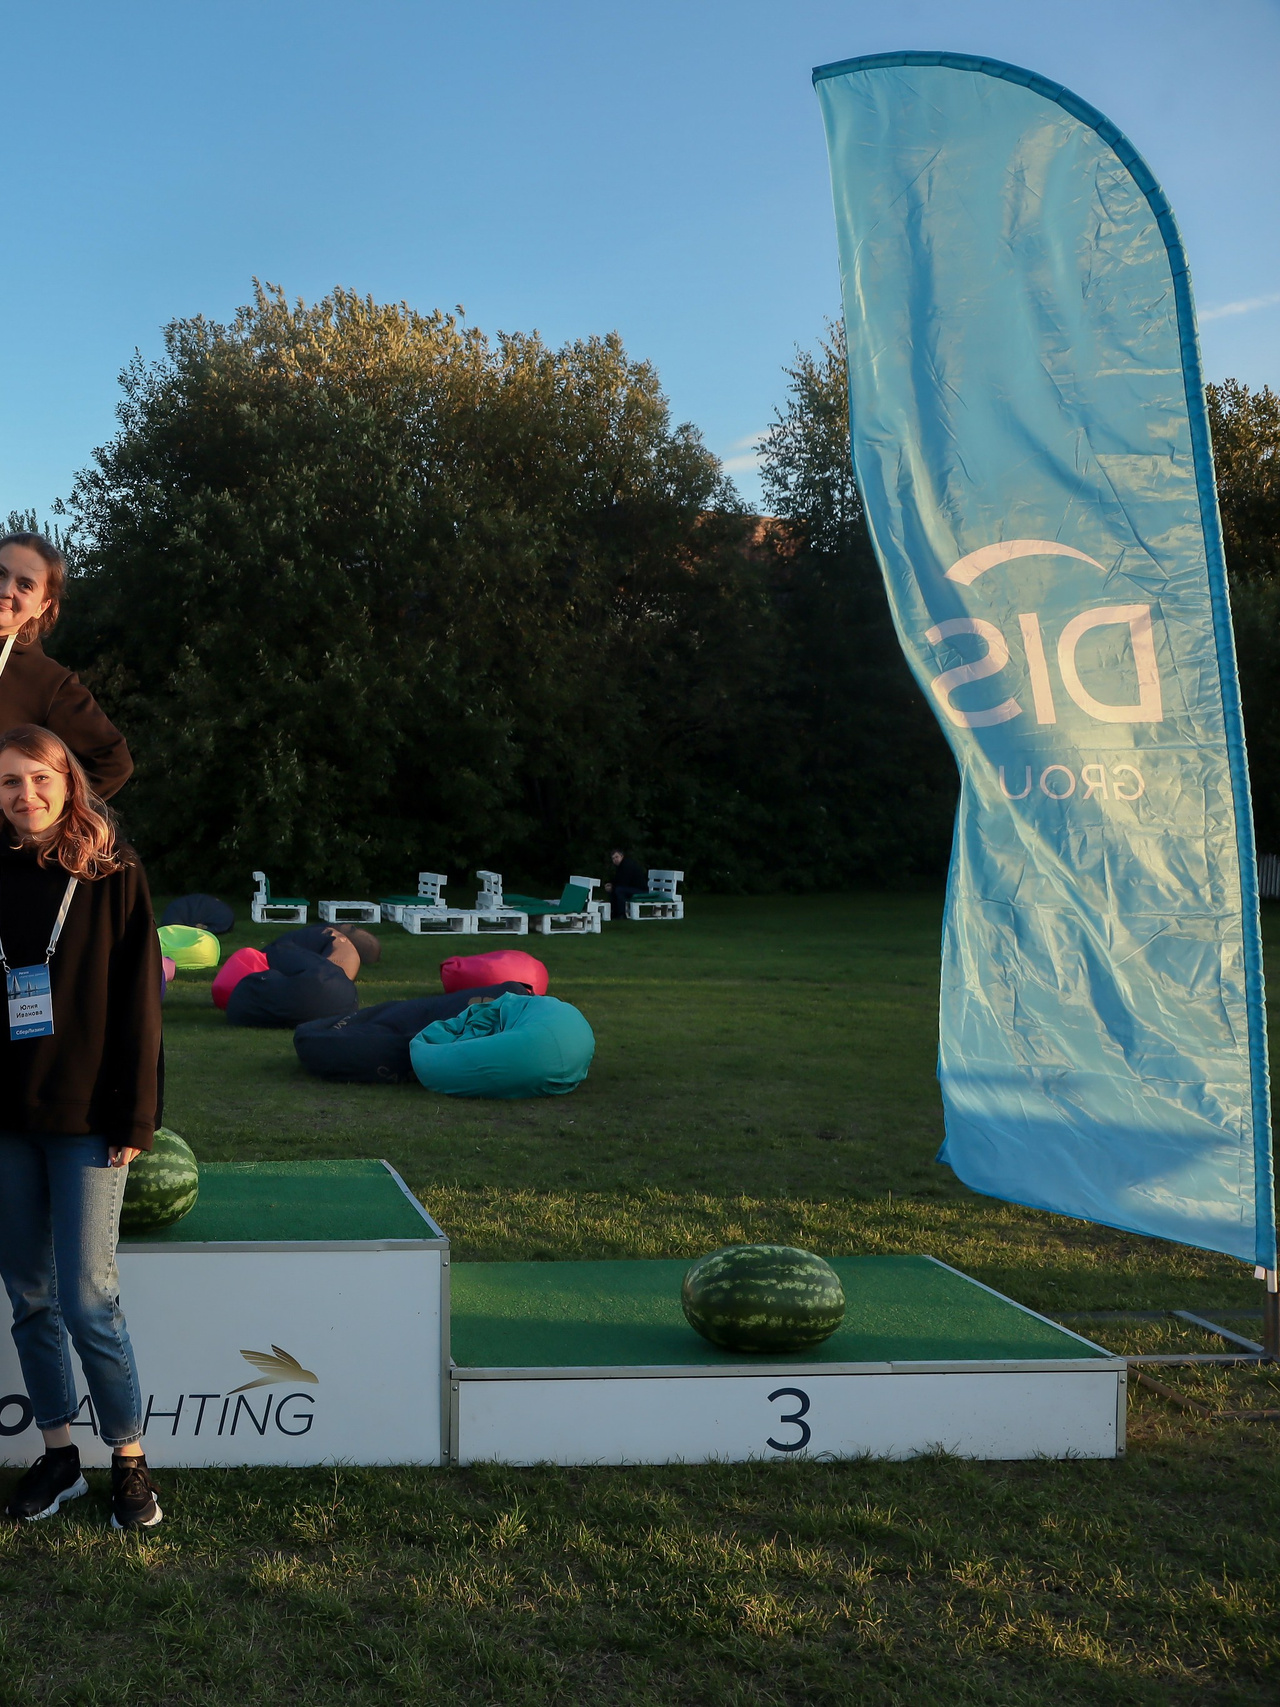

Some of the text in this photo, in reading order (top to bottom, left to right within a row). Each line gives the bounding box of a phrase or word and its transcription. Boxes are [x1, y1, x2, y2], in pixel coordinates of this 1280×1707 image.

[19, 1003, 39, 1011] Юлия
[16, 1010, 43, 1019] Иванова
[765, 1386, 812, 1453] 3
